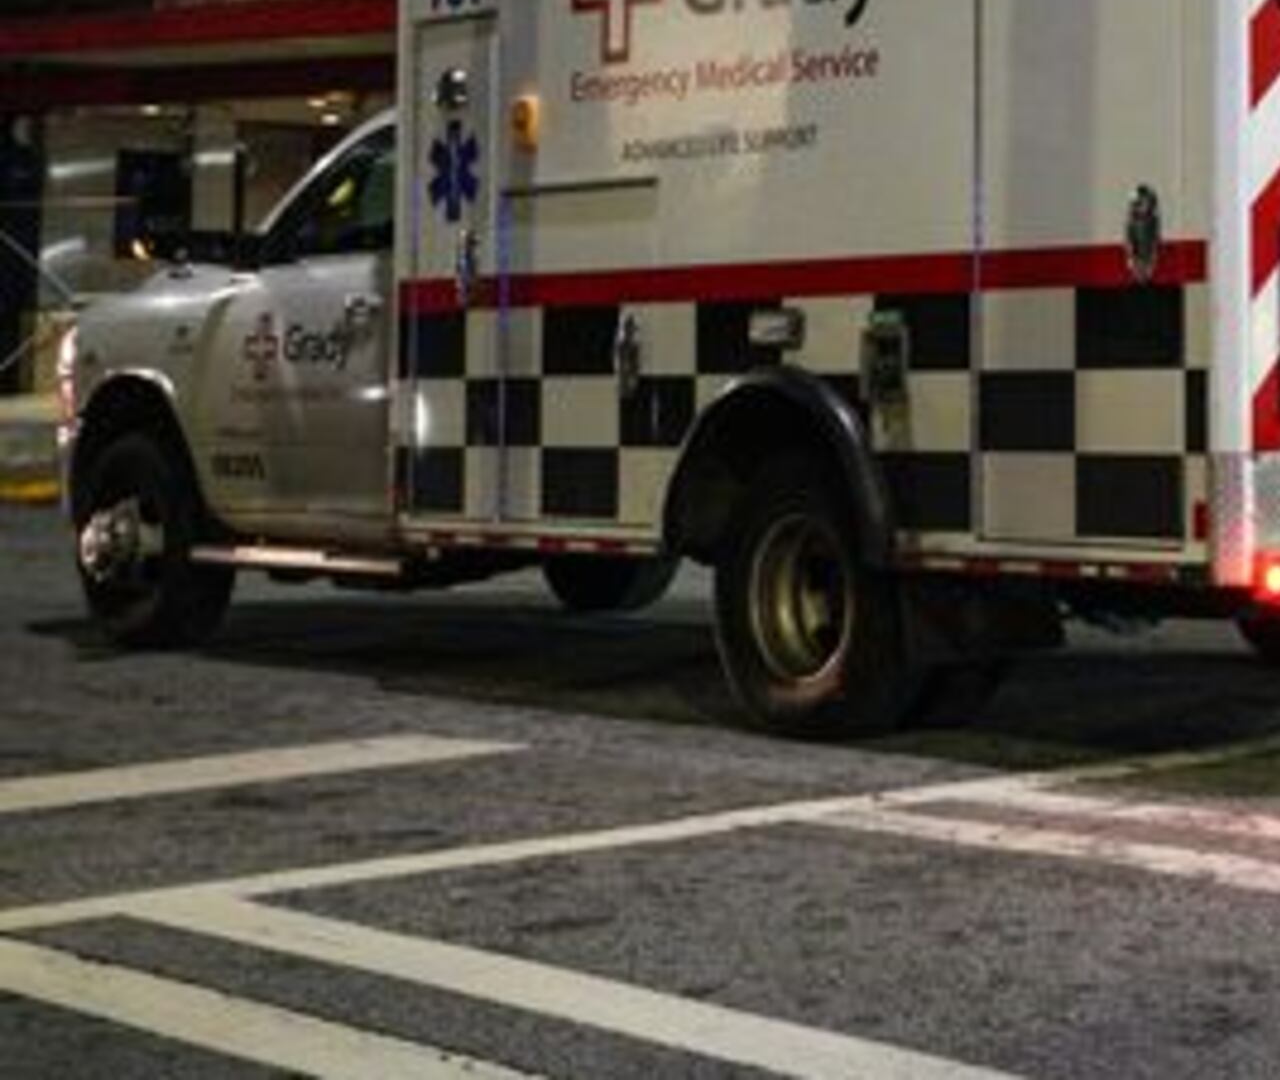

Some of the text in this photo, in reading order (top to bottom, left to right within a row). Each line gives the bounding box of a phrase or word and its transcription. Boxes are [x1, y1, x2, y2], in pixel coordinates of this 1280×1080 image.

[570, 45, 880, 106] Emergency Medical Service
[282, 322, 350, 370] Grady
